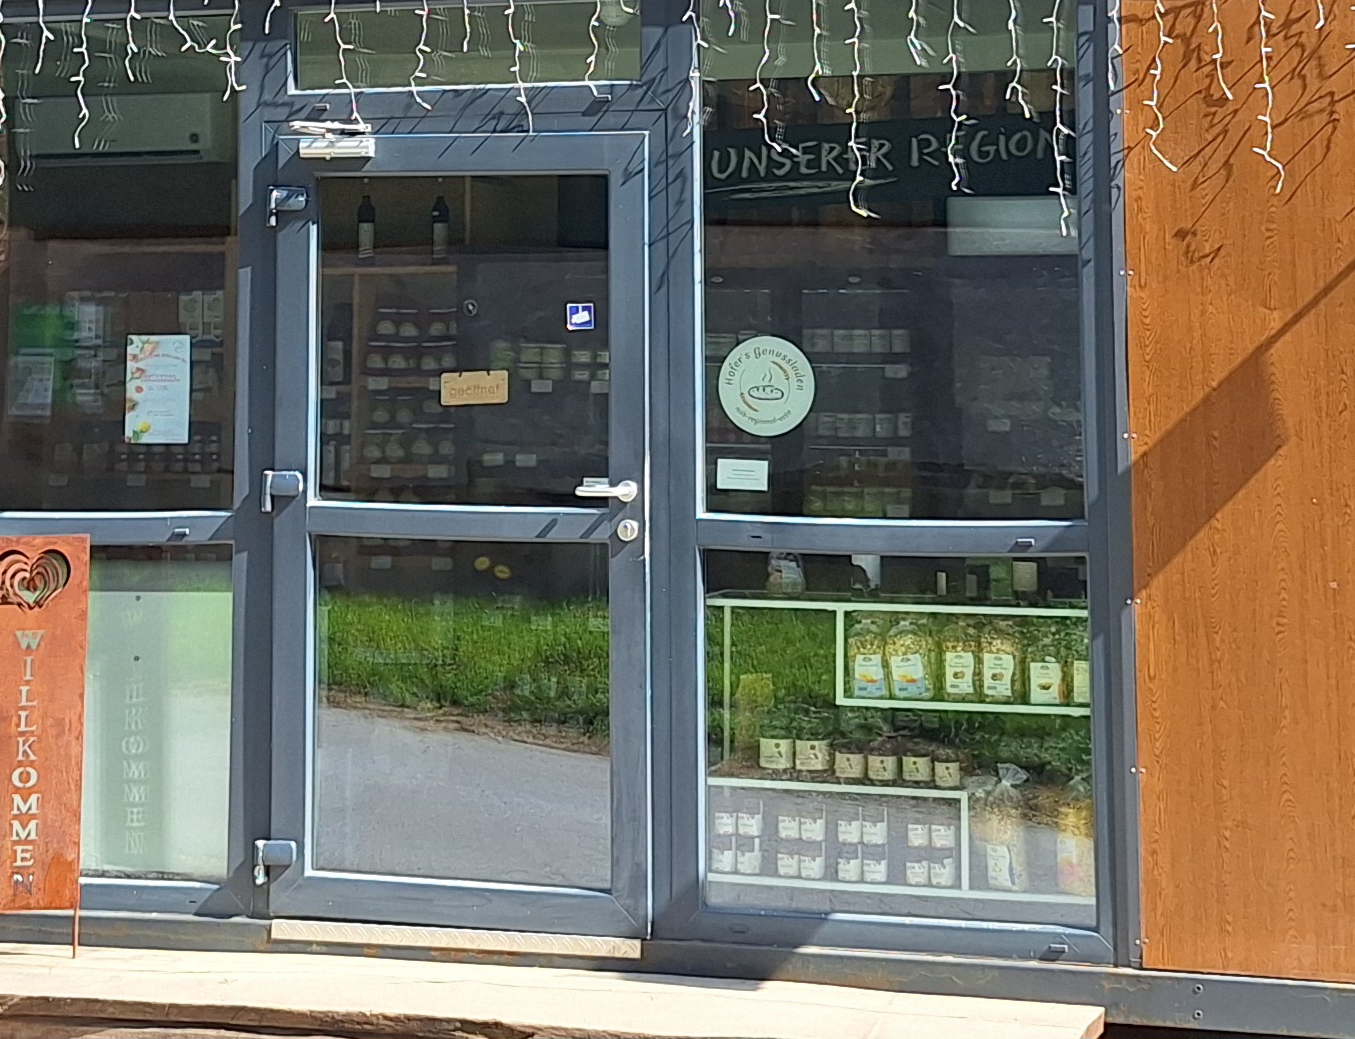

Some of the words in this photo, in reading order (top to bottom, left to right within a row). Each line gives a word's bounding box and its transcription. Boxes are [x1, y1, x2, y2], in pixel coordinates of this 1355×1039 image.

[710, 138, 894, 180] UNSERER
[723, 351, 751, 386] Hofer's
[753, 346, 804, 391] Genussladen
[10, 629, 46, 896] WILLKOMMEN
